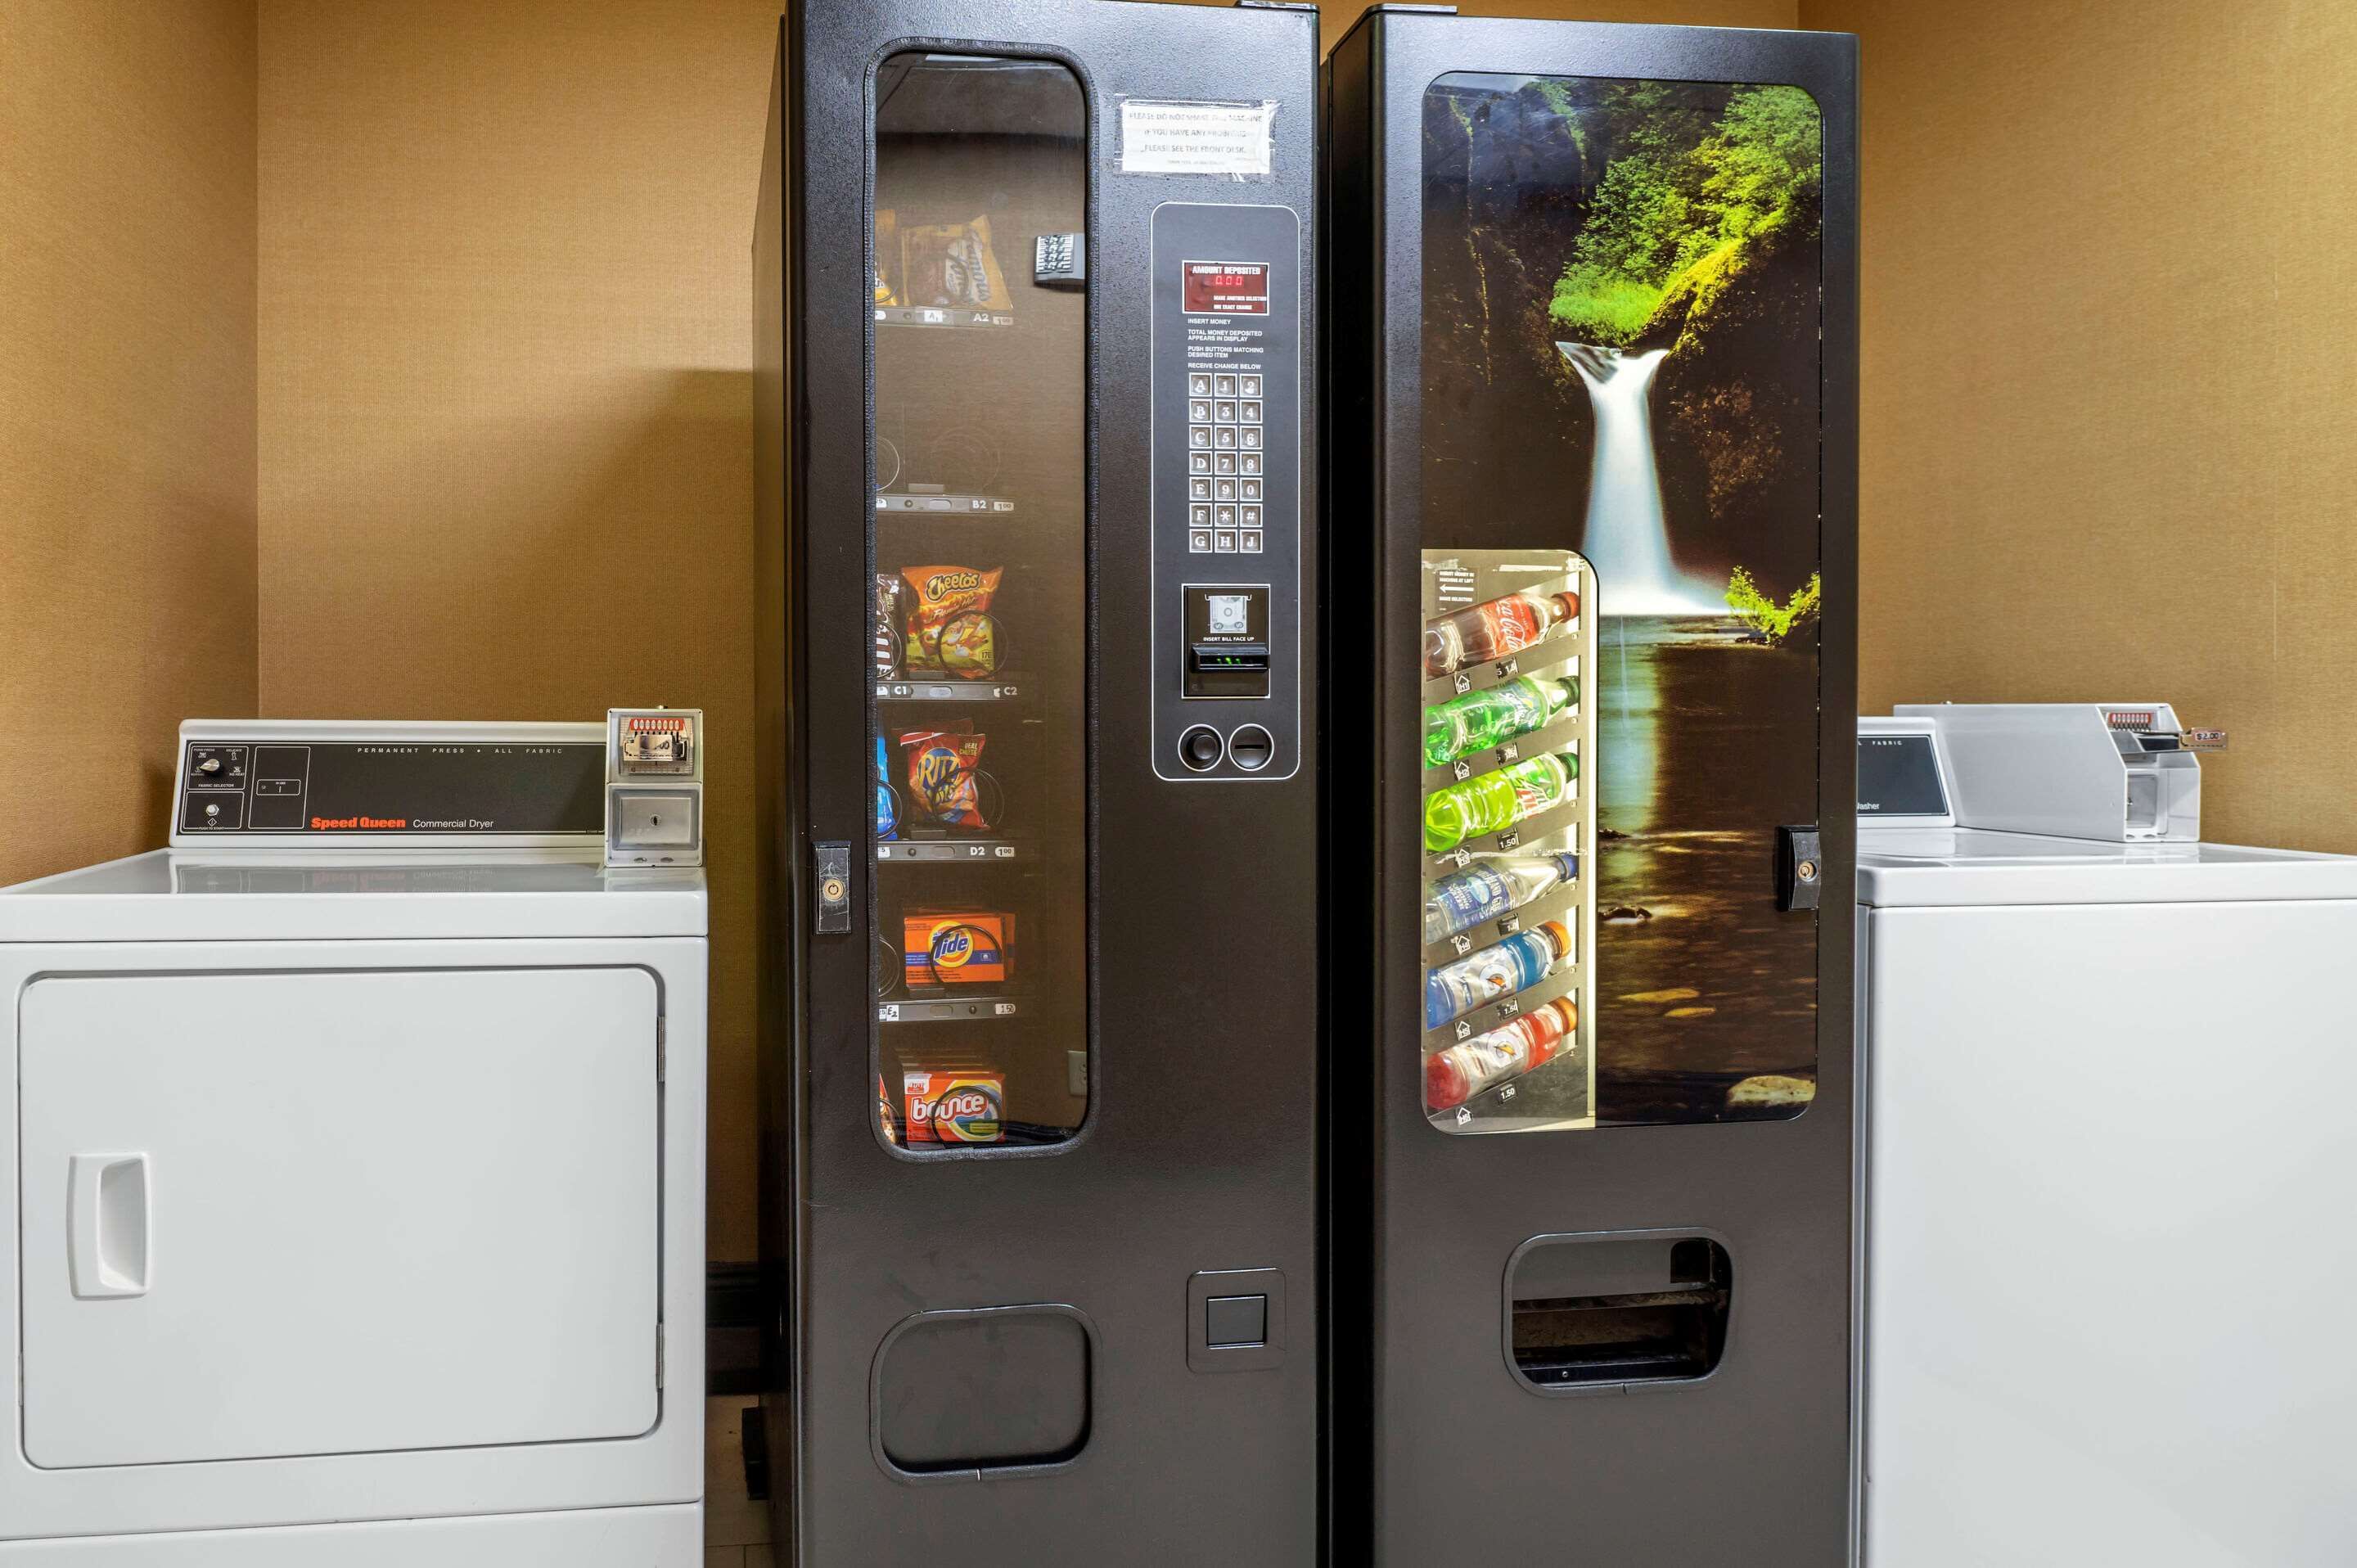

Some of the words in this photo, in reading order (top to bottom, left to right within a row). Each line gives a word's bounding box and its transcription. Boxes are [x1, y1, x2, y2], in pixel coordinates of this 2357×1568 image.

[1185, 145, 1200, 153] THE
[1192, 266, 1223, 274] AMOUNT
[1224, 267, 1261, 275] DEPOSITED
[973, 313, 989, 322] A2
[1196, 380, 1206, 391] A
[1221, 381, 1228, 391] 1
[1246, 381, 1255, 392] 2
[1196, 405, 1206, 417] B
[1221, 407, 1230, 417] 3
[1246, 407, 1255, 417] 4
[1195, 431, 1206, 443] C
[1222, 432, 1230, 443] 5
[1246, 432, 1255, 444] 6
[1197, 457, 1206, 469] D
[1221, 458, 1229, 469] 7
[1246, 458, 1255, 470] 8
[1196, 484, 1206, 495] E
[1221, 484, 1230, 495] 9
[1246, 484, 1255, 495] 0
[972, 499, 987, 509] B2
[1197, 510, 1206, 521] F
[1195, 536, 1206, 547] G
[1220, 536, 1231, 547] H
[1246, 537, 1255, 547] J
[926, 572, 980, 602] Cheetos
[894, 686, 908, 695] C1
[1003, 687, 1018, 696] C2
[2197, 732, 2220, 741] $2.00
[917, 754, 961, 787] RITZ
[311, 817, 358, 830] Speed
[359, 817, 406, 829] Queen
[412, 819, 466, 828] Commercial
[469, 819, 494, 830] Dryer
[1499, 837, 1517, 849] 1.50
[970, 846, 985, 856] D2
[931, 932, 970, 961] Tide
[1500, 1087, 1515, 1099] 1.50
[911, 1095, 987, 1122] bounce
